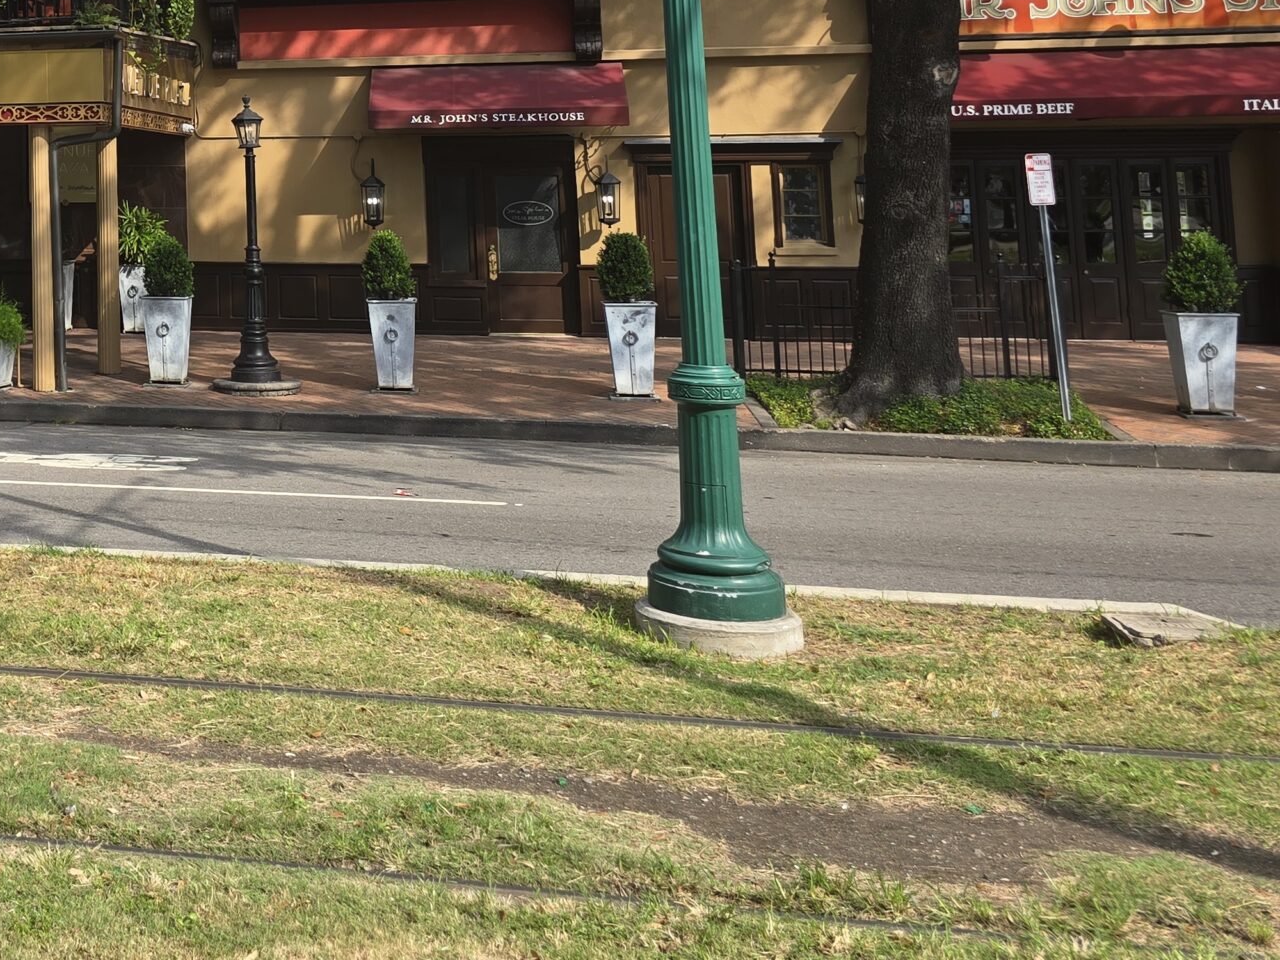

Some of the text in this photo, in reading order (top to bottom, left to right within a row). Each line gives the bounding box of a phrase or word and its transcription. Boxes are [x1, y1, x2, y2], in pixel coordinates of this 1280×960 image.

[951, 102, 1075, 117] U.S. PRIME BEEF
[410, 112, 585, 126] MR. JOHN'S STEAKHOUSE
